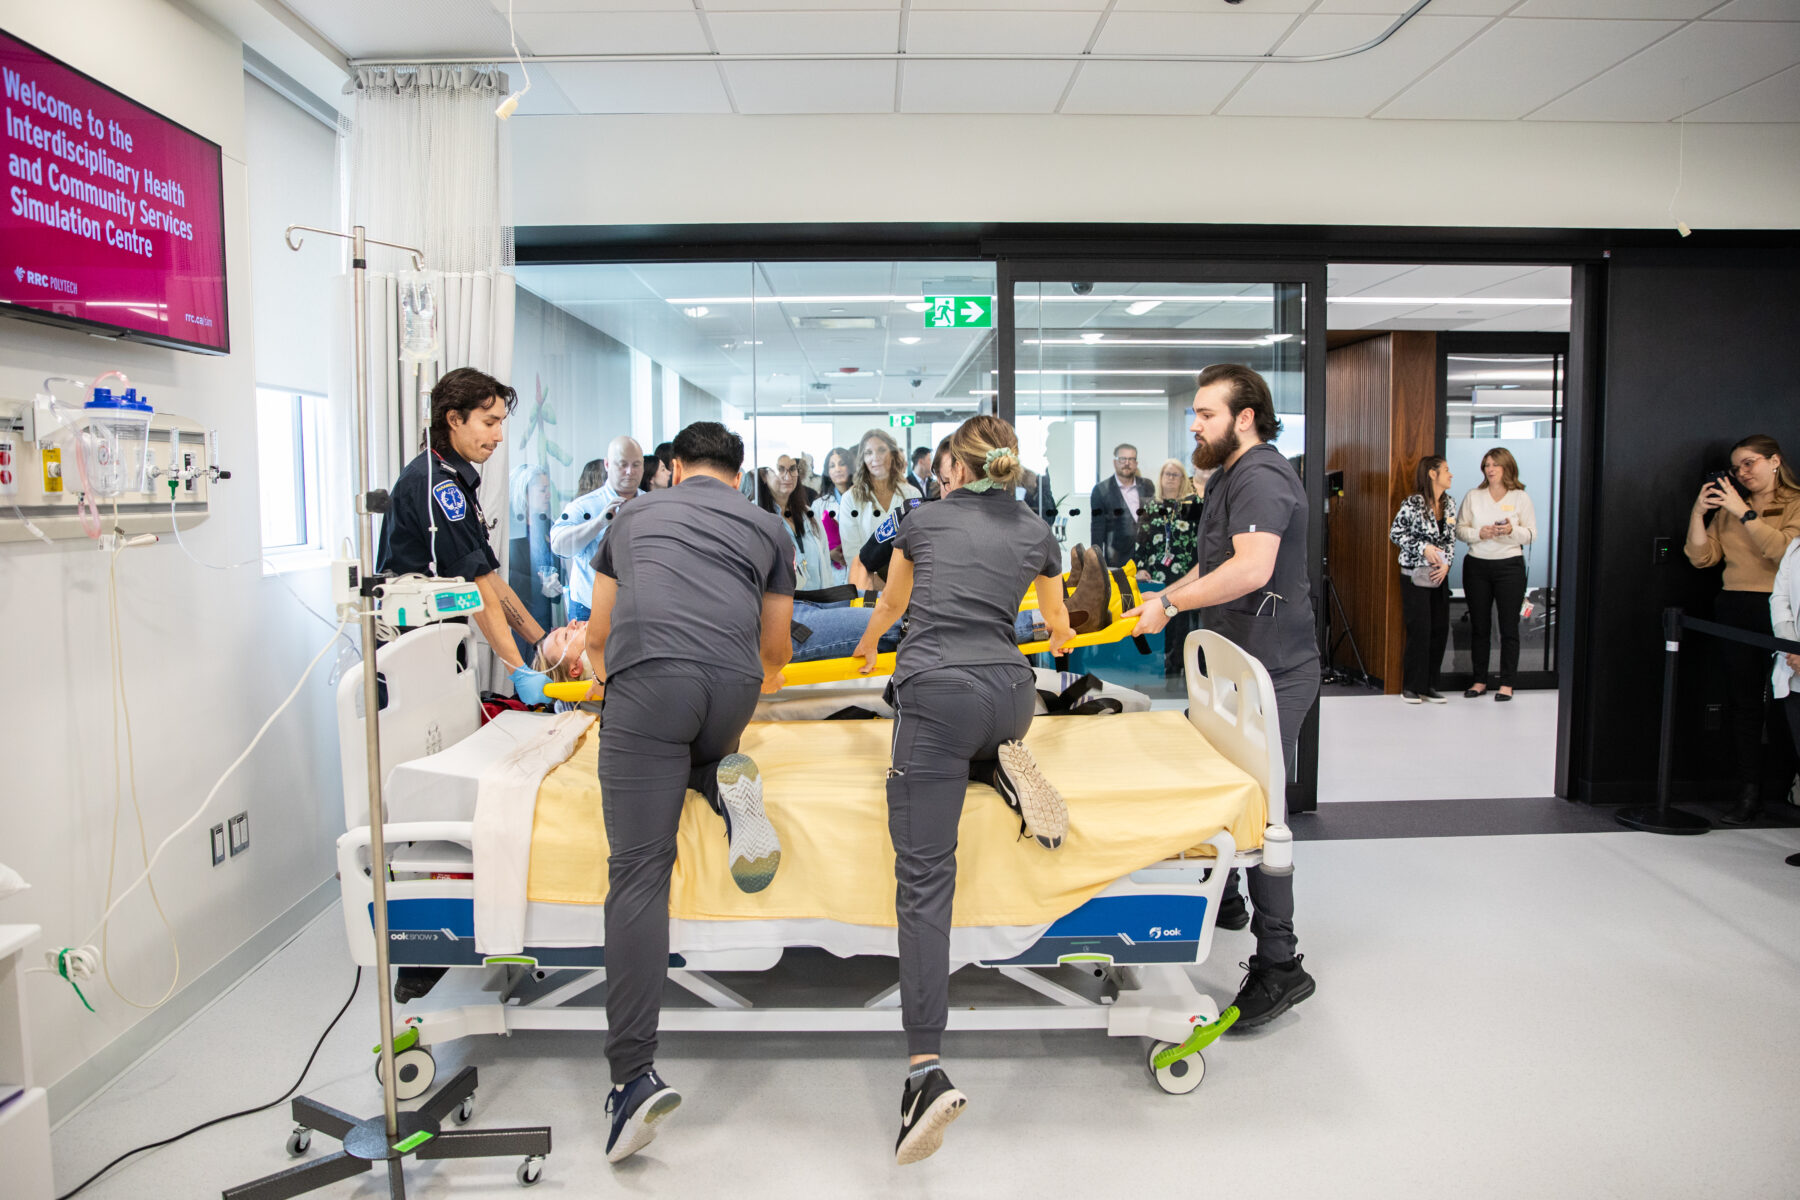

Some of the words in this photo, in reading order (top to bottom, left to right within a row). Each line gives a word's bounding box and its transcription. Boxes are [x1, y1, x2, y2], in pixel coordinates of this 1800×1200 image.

[3, 66, 82, 130] Welcome
[87, 108, 104, 140] to
[108, 119, 133, 153] the
[6, 106, 139, 194] Interdisciplinary
[144, 168, 185, 208] Health
[8, 153, 42, 186] and
[48, 163, 135, 225] Community
[140, 199, 193, 241] Services
[10, 186, 102, 242] Simulation
[105, 219, 152, 258] Centre
[27, 270, 49, 287] RRC
[50, 276, 78, 295] POLYTECH
